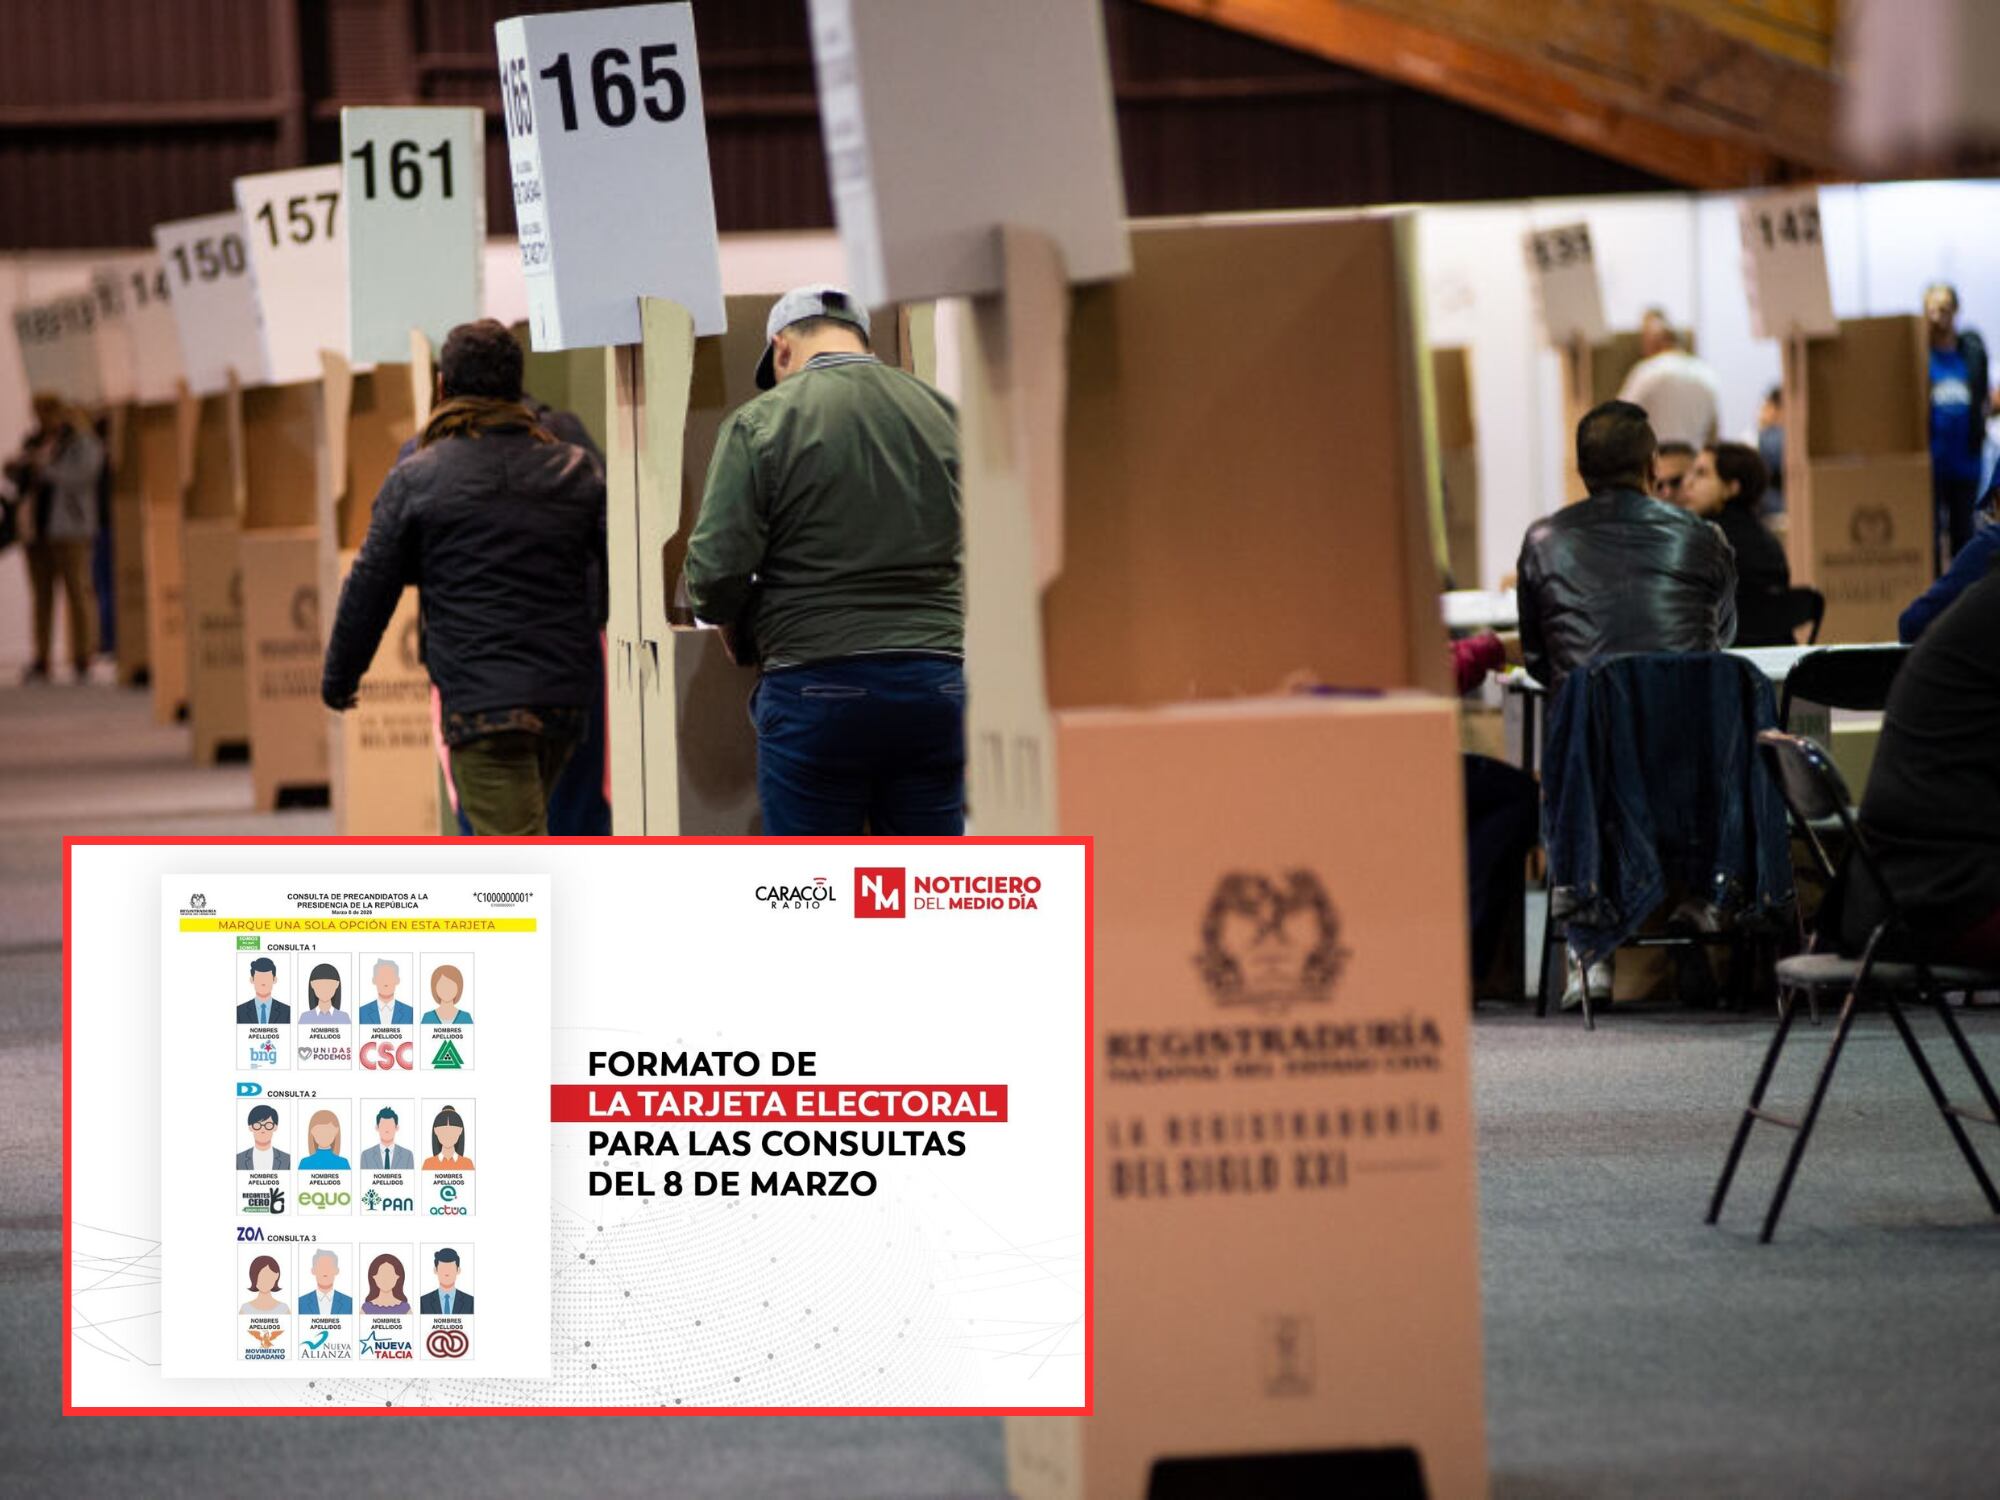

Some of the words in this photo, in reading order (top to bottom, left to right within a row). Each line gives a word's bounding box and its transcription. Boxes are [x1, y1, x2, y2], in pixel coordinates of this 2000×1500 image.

[540, 43, 687, 133] 165
[350, 140, 455, 200] 161
[256, 192, 339, 247] 157
[172, 233, 247, 284] 150
[1110, 1157, 1171, 1199] DEL
